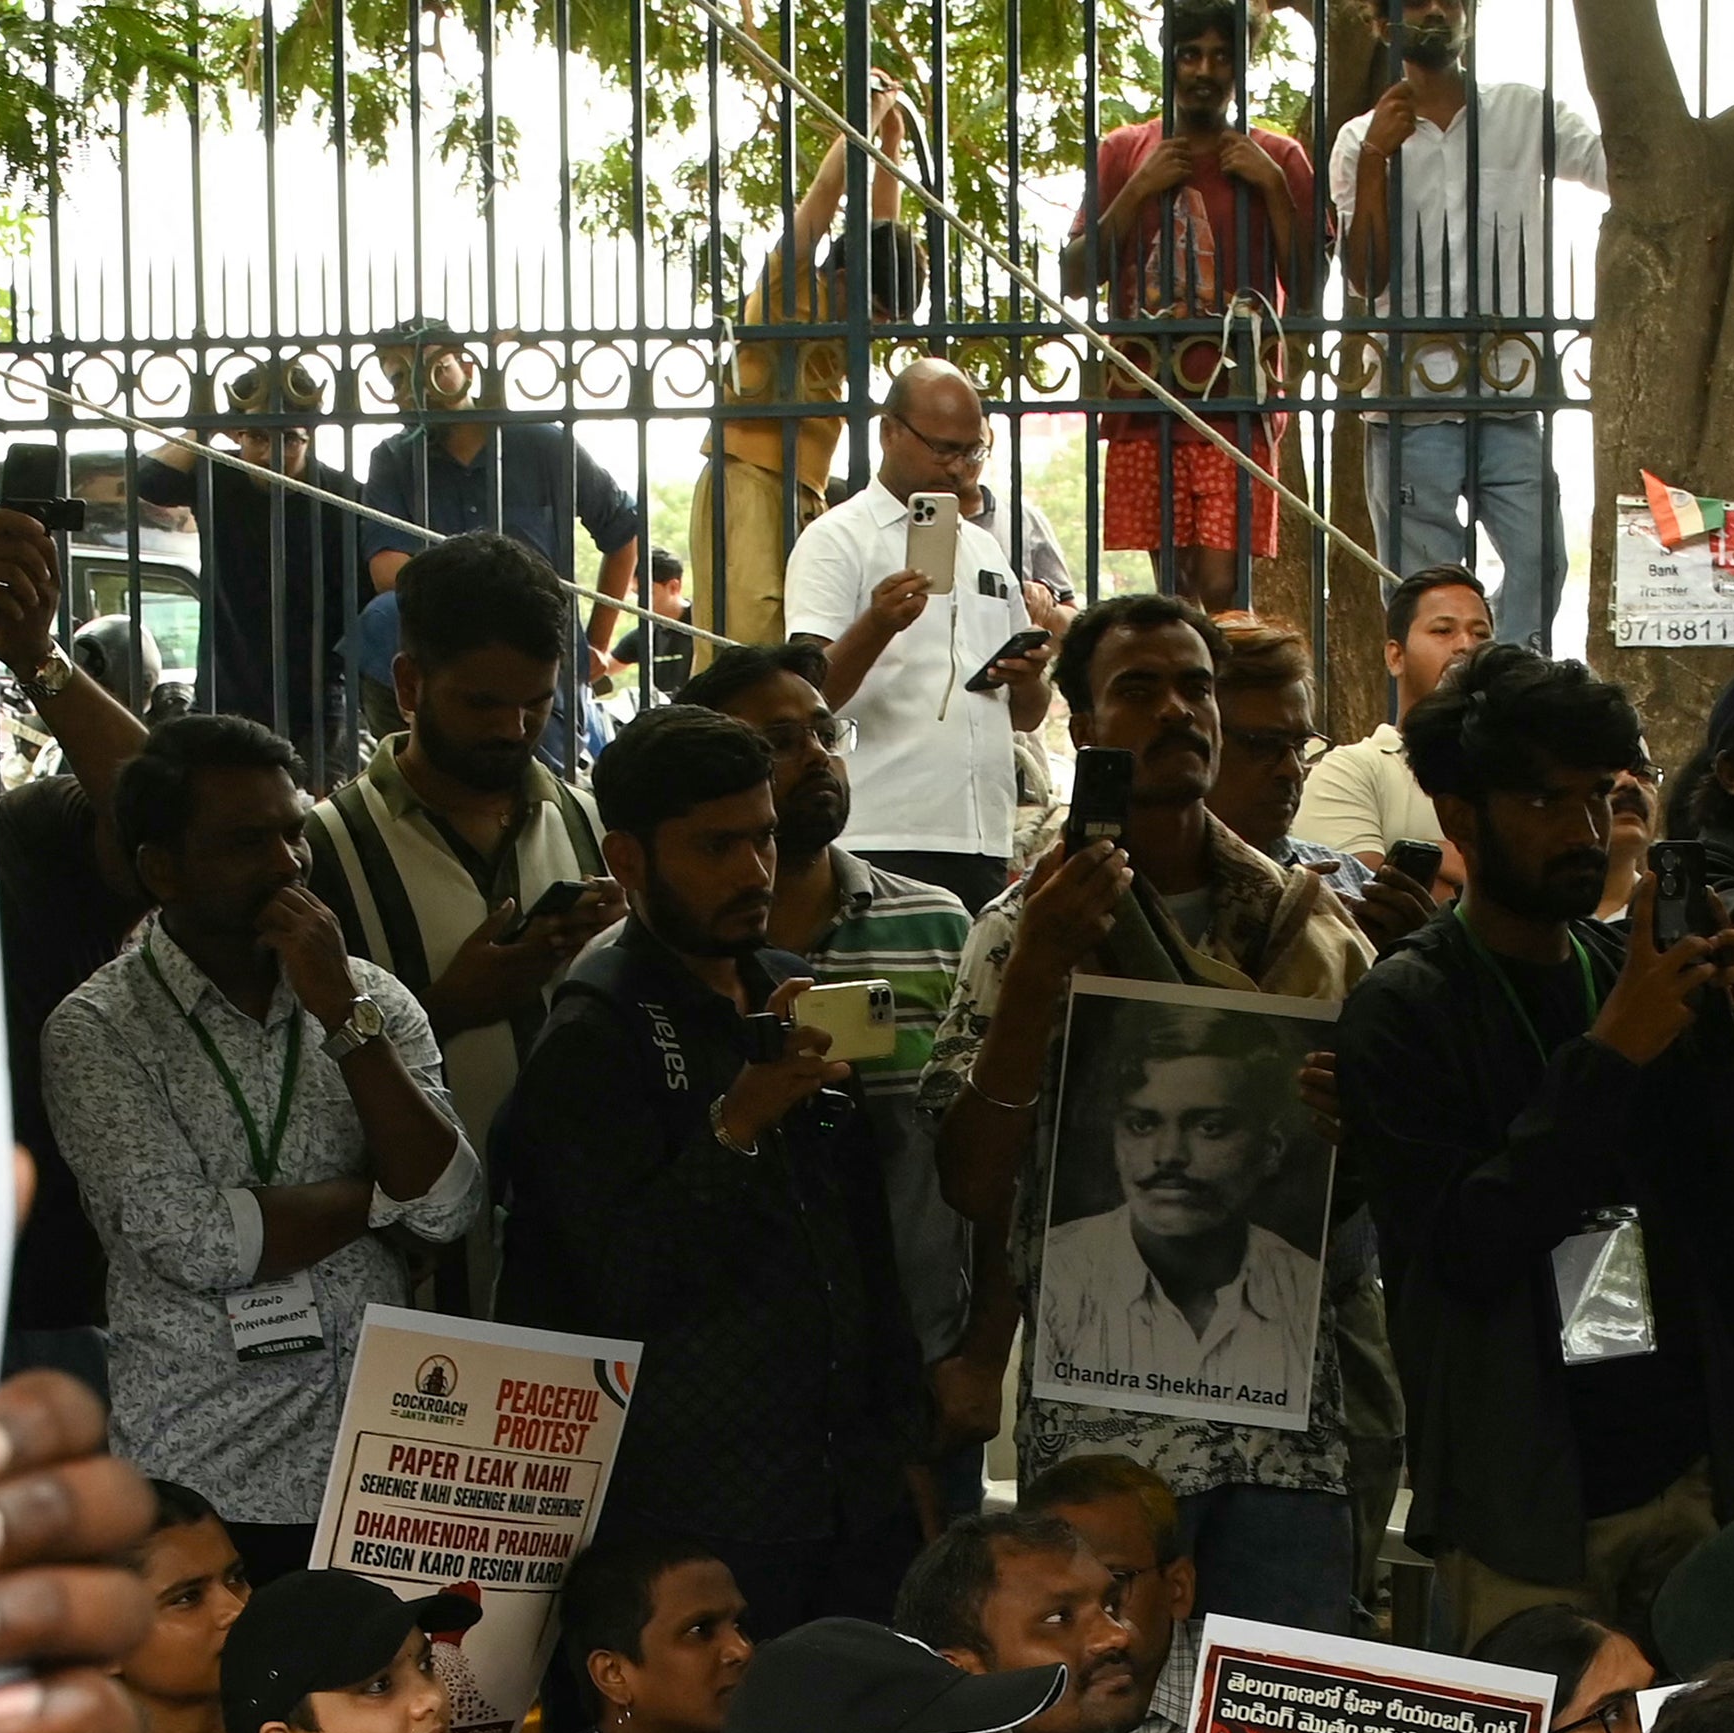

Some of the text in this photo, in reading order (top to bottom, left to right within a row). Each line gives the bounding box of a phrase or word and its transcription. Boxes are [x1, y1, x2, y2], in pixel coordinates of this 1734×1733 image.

[1648, 564, 1679, 577] Bank
[638, 1001, 689, 1091] safari
[234, 1310, 308, 1332] MANAGEMENT
[241, 1295, 283, 1310] CROWD
[393, 1392, 468, 1417] COCKROACH
[496, 1378, 599, 1423] PEACEFUL
[1054, 1362, 1288, 1406] Chandra Shekhar Azad
[399, 1409, 456, 1426] JANTA PARTY
[493, 1414, 590, 1455] PROTEST
[387, 1444, 571, 1493] PAPER LEAK NAHI
[360, 1474, 584, 1518] SEHENGE NAHI SEHENGE NAHI SEHENGE
[354, 1510, 574, 1558] DHARMENDRA PRADHAN
[351, 1540, 563, 1584] RESIGN KARO RESIGN KARO
[1221, 1699, 1295, 1729] పెండింగ్
[1228, 1672, 1340, 1709] తెలంగాణలో
[1344, 1687, 1382, 1716] ఫీజు
